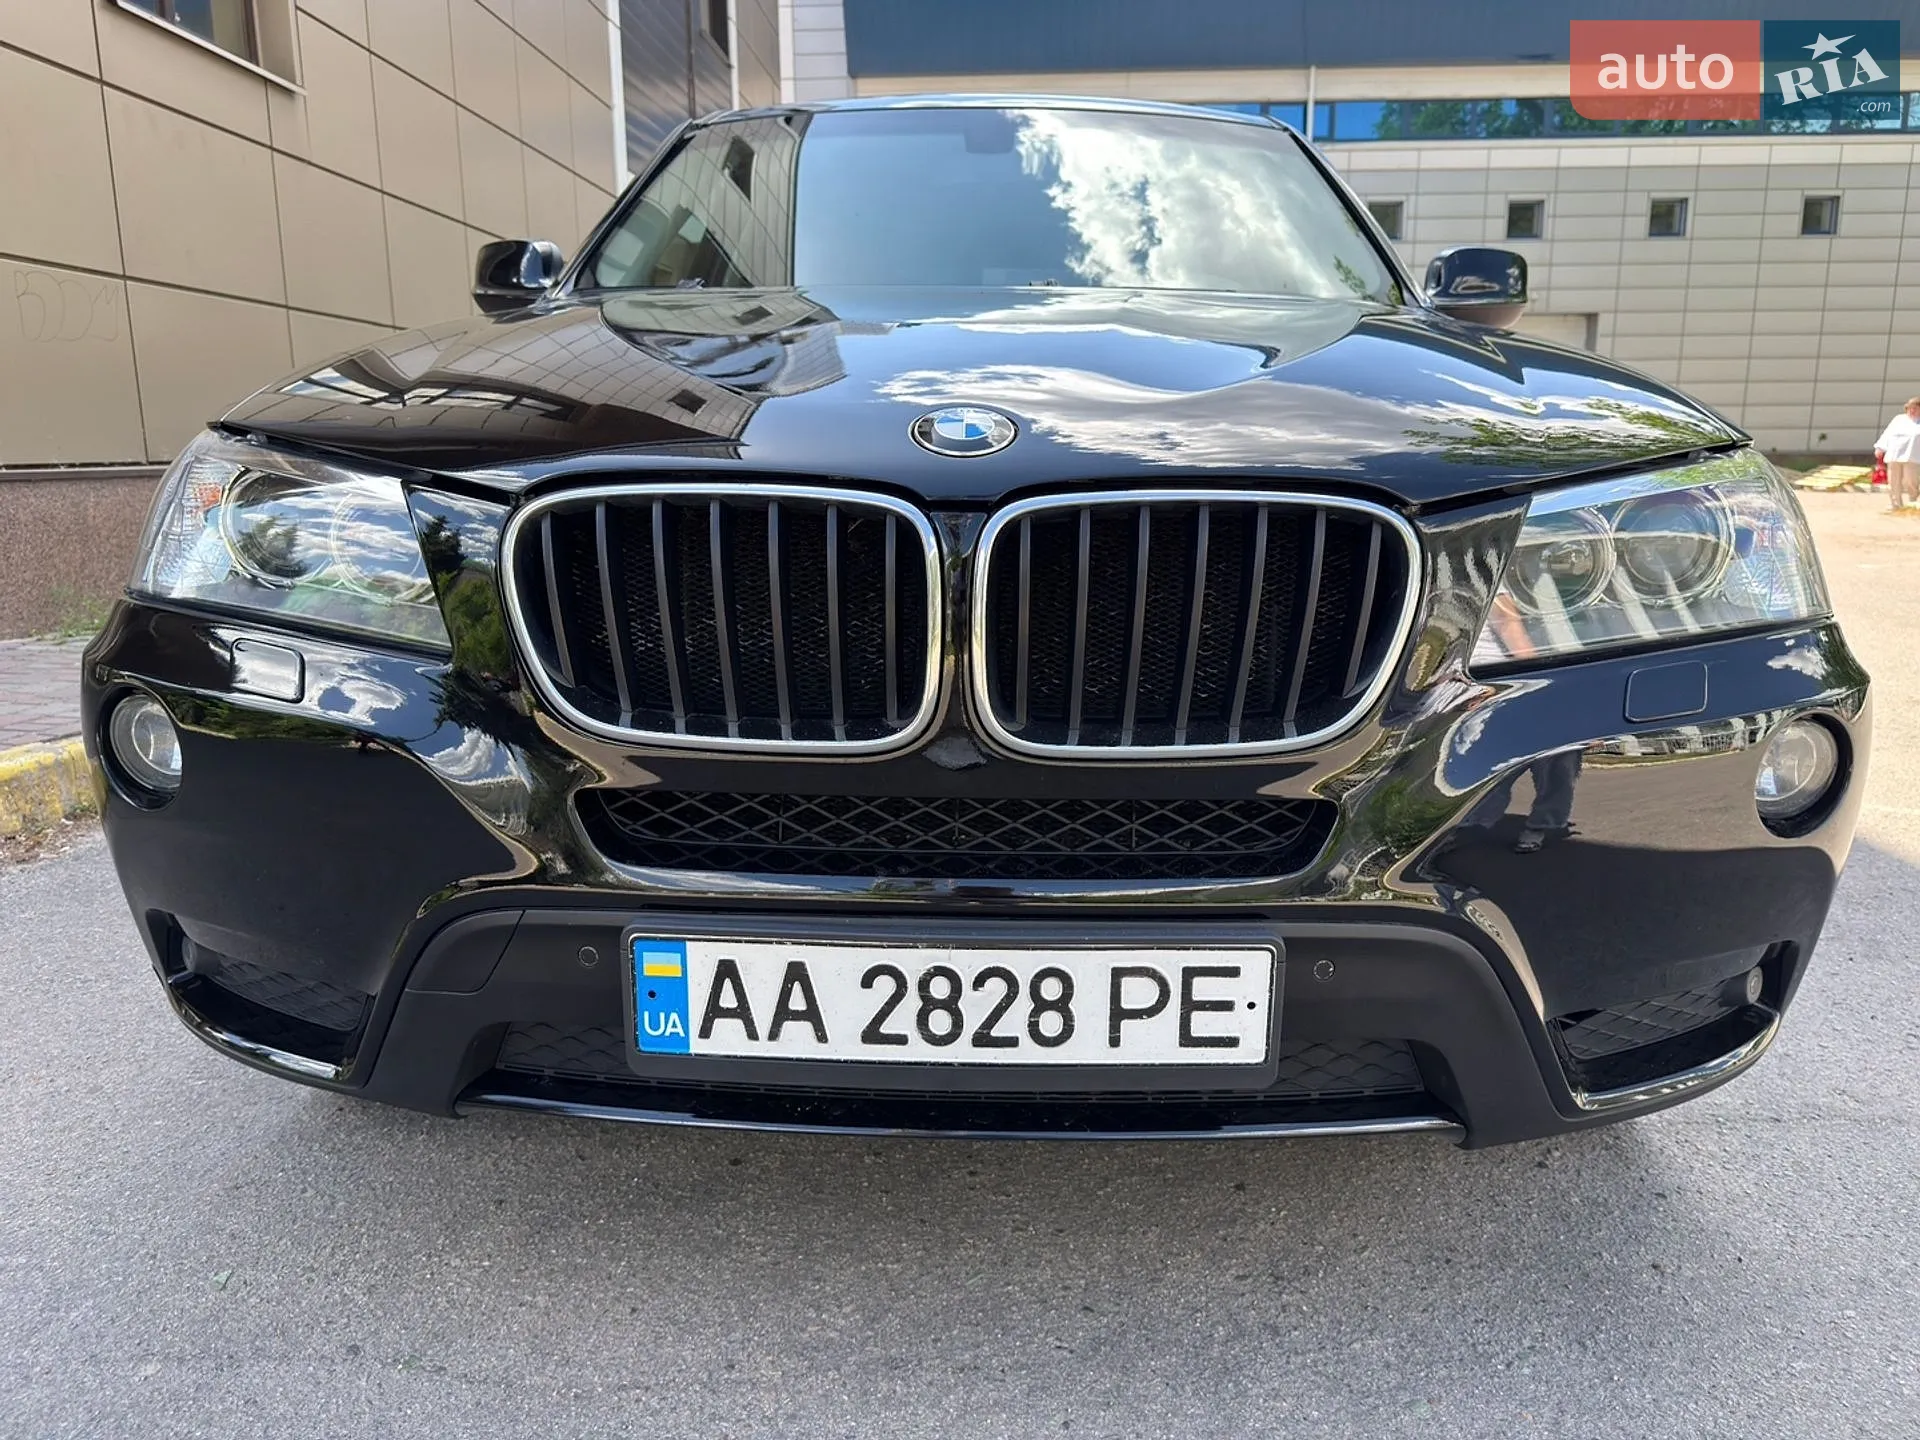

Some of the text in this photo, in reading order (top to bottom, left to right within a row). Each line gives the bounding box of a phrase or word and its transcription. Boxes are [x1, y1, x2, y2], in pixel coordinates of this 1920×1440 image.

[643, 1011, 685, 1037] UA
[697, 958, 1242, 1048] AA 2828 PE
